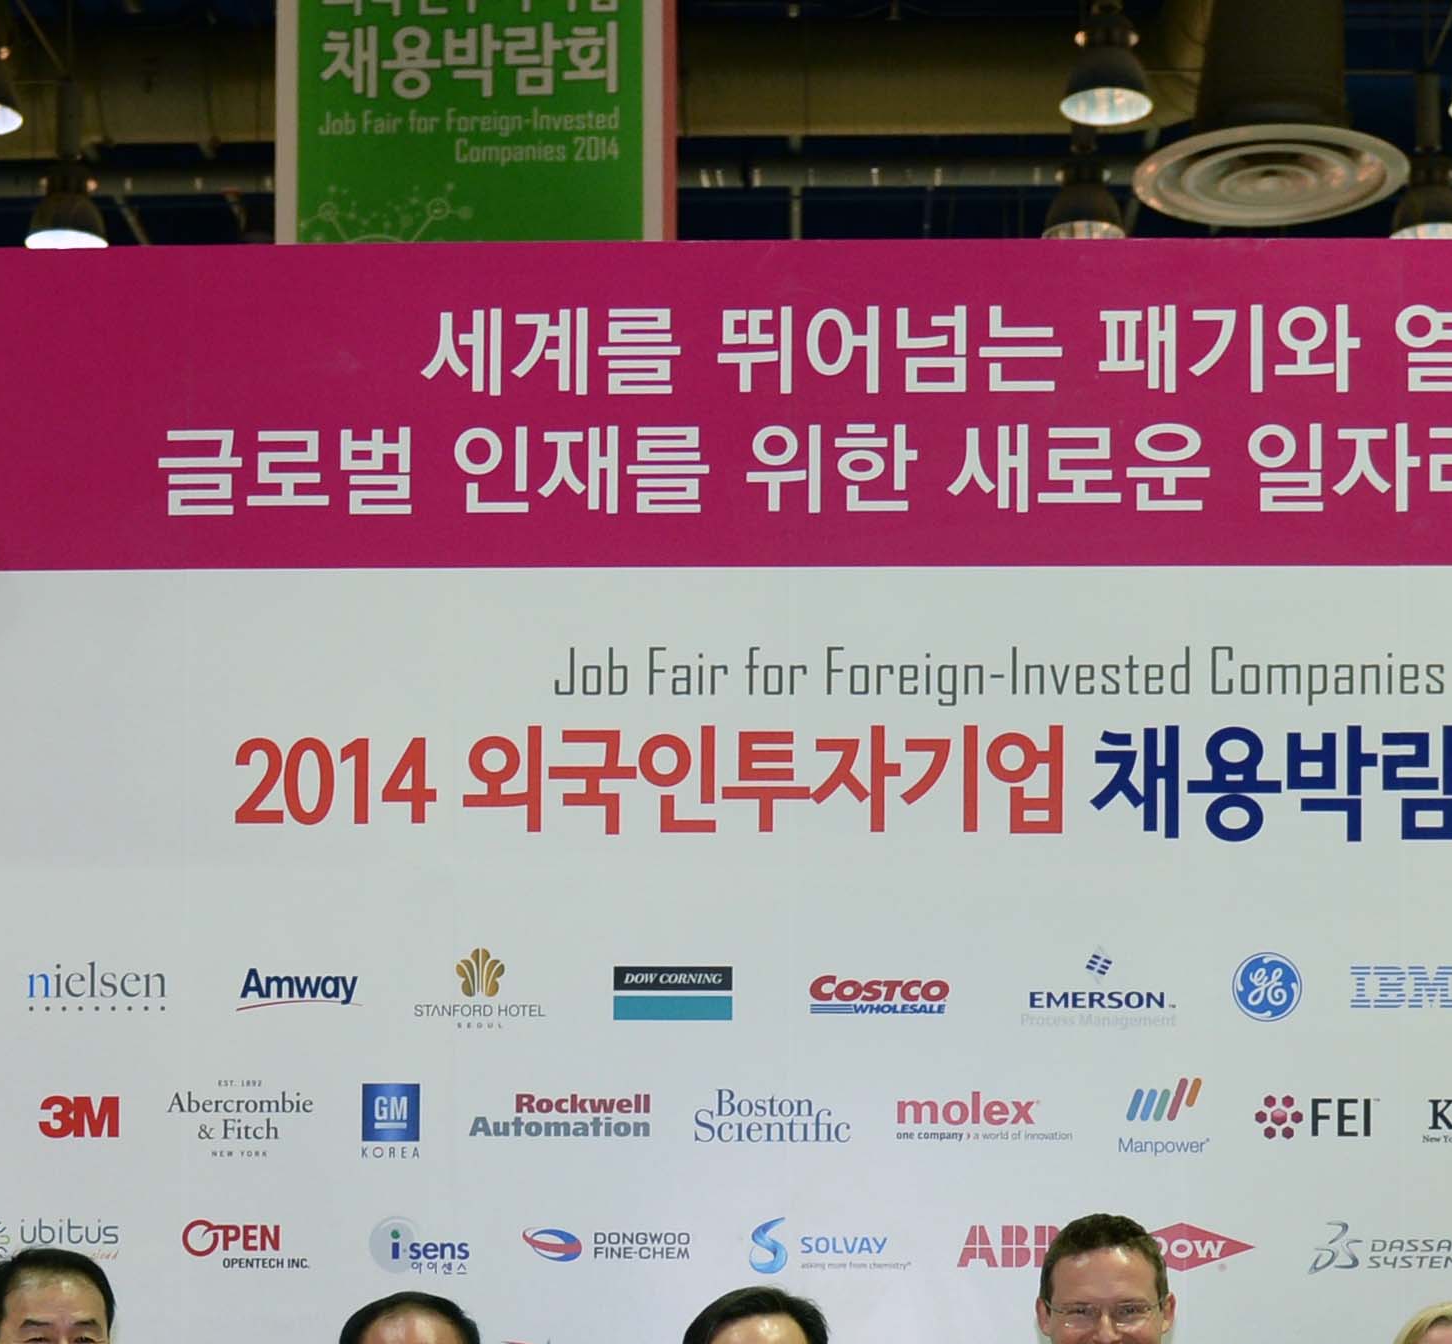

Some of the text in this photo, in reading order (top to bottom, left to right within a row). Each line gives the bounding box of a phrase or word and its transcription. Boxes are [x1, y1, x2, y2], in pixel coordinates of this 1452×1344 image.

[319, 20, 619, 99] 채용박람회
[318, 107, 620, 136] Job Fair for Foreign-Invested
[455, 137, 619, 166] Companies 2014
[420, 306, 683, 396] 세계를
[717, 304, 1063, 395] 뛰어넘는
[1098, 303, 1361, 394] 패기와
[157, 426, 412, 516] 글로벌
[453, 425, 710, 515] 인재를
[745, 423, 918, 514] 위한
[946, 422, 1212, 513] 새로운
[554, 646, 628, 696] Job
[648, 646, 729, 696] Fair
[744, 646, 808, 696] for
[826, 645, 1191, 707] Foreign-Invested
[1211, 645, 1445, 707] Companies
[234, 736, 438, 826] 2014
[462, 724, 1064, 836] 외국인투자기업
[28, 961, 166, 999] nielsen
[238, 967, 359, 1006] Amway
[623, 972, 723, 985] DOW CORNING
[809, 974, 950, 1002] COSTCO
[413, 1003, 546, 1018] STANFORD HOTEL
[852, 1003, 947, 1016] WHOLESALE
[1029, 991, 1165, 1009] EMERSON
[456, 1021, 502, 1029] SEOUL
[1021, 1014, 1177, 1032] Process Management
[167, 1090, 314, 1116] Abercrombie
[373, 1096, 408, 1120] GM
[515, 1093, 651, 1116] Rockwell
[715, 1088, 814, 1117] Boston
[896, 1090, 1035, 1126] molex
[37, 1095, 120, 1139] 3M
[197, 1117, 279, 1140] & Fitch
[468, 1115, 651, 1138] Automation
[694, 1108, 851, 1143] Scientific
[1311, 1098, 1371, 1137] FEI
[896, 1131, 915, 1140] one
[916, 1131, 964, 1142] company
[981, 1128, 1010, 1141] world
[1023, 1128, 1074, 1142] innovation
[1422, 1134, 1442, 1143] New
[211, 1150, 267, 1158] NEW YORK
[361, 1146, 420, 1159] KOREA
[1118, 1137, 1205, 1157] Manpower
[20, 1217, 119, 1247] ubitus
[181, 1219, 281, 1258] OPEN
[593, 1231, 691, 1246] DONGWOO
[593, 1246, 690, 1260] FINE-CHEM
[800, 1236, 888, 1255] SOLVAY
[222, 1257, 310, 1269] OPENTECH INC.
[409, 1261, 468, 1276] 아이센스
[800, 1262, 828, 1271] asking
[848, 1260, 867, 1269] from
